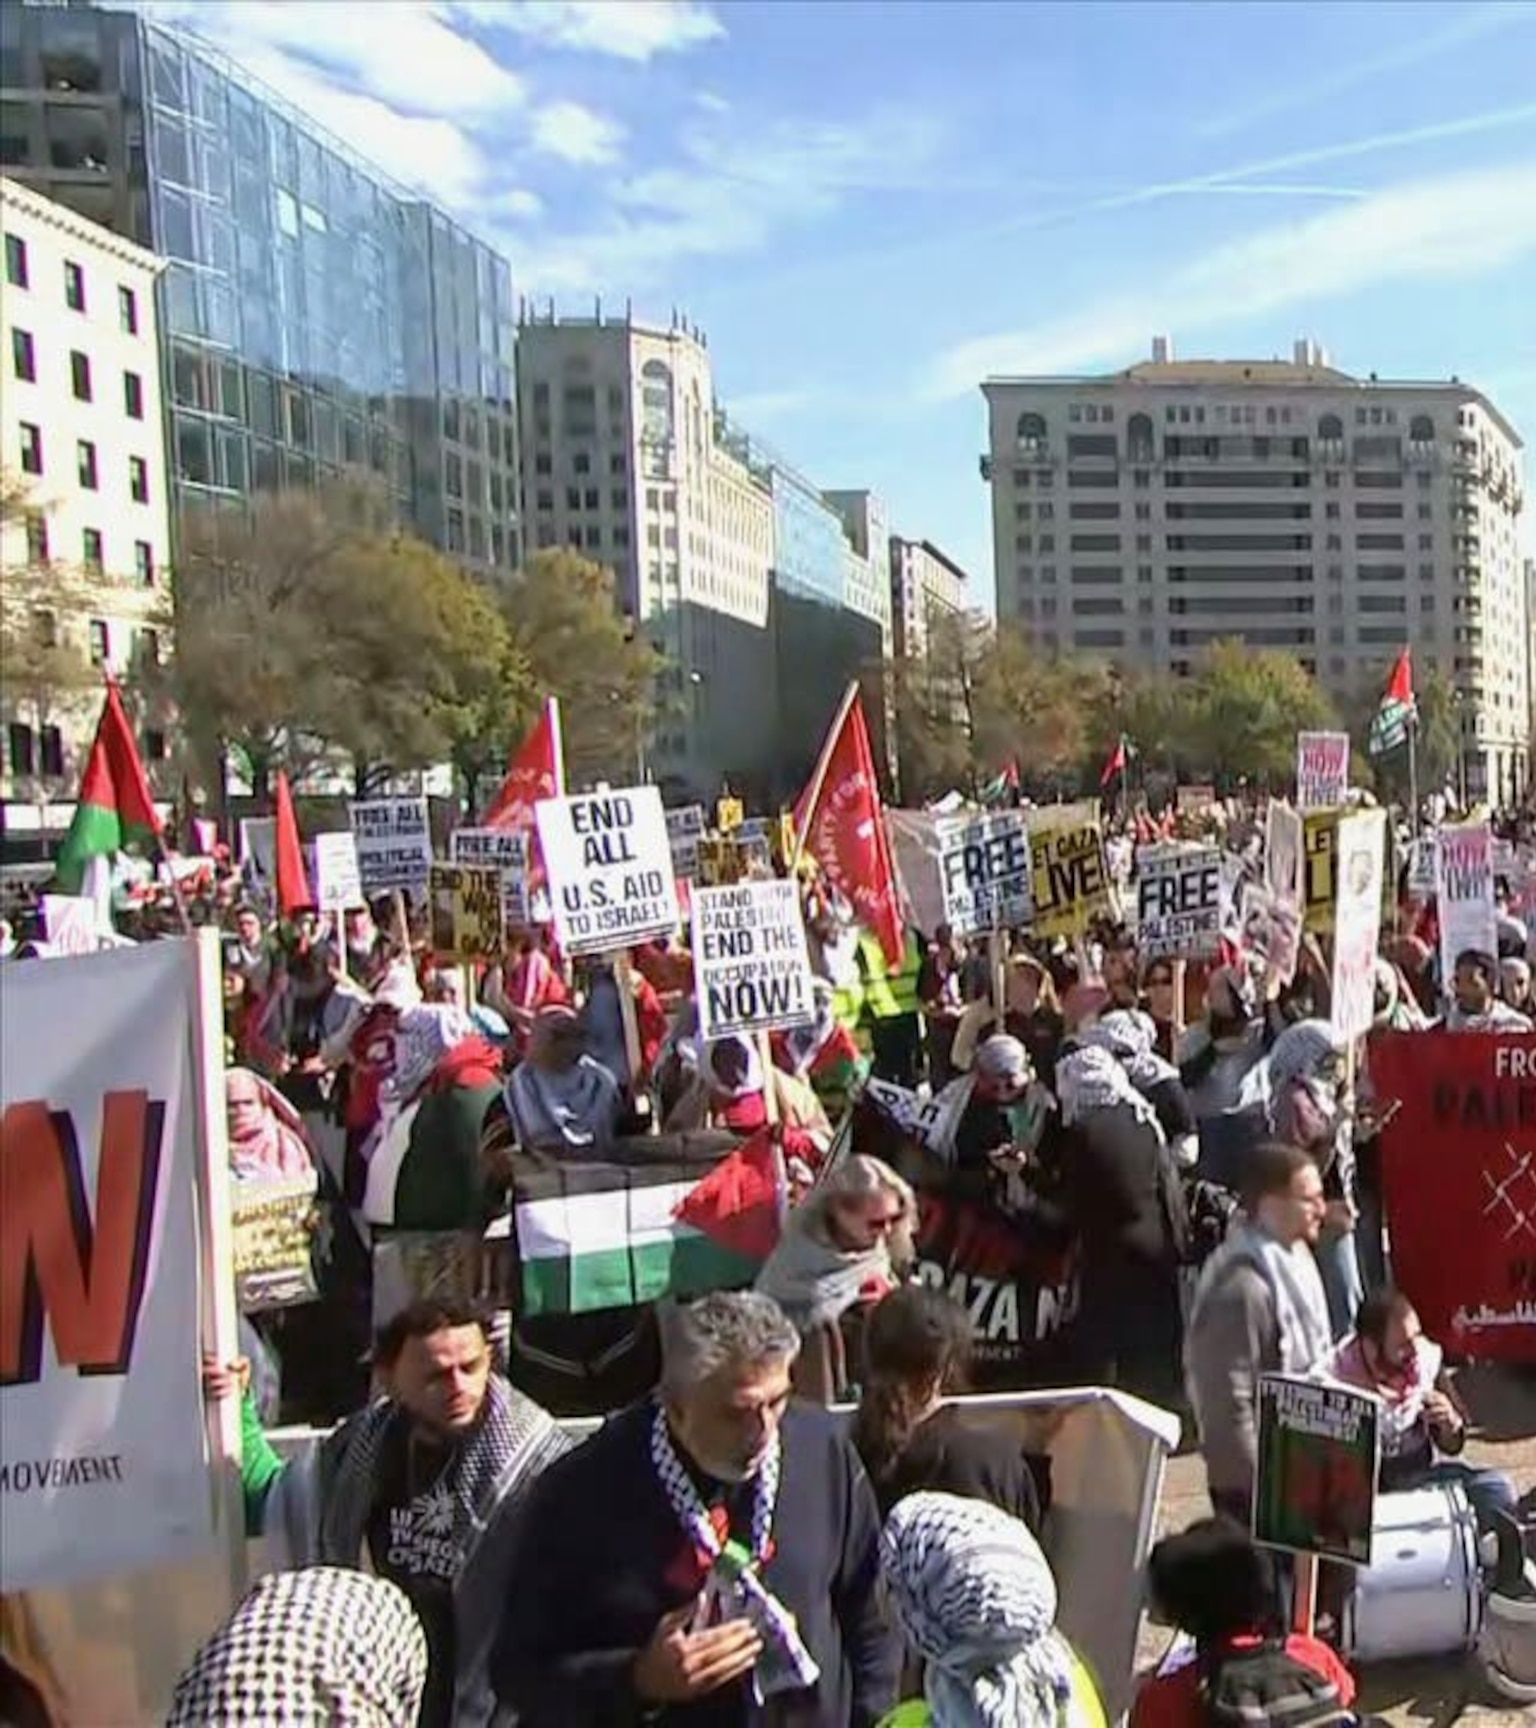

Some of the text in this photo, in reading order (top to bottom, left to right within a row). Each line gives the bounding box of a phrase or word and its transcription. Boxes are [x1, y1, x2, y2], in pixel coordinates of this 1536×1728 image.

[570, 797, 633, 834] END
[584, 832, 637, 868] ALL
[943, 829, 1027, 894] FREE
[562, 870, 664, 912] U.S. AID
[700, 888, 752, 910] STAND
[1140, 868, 1219, 919] FREE
[565, 915, 591, 936] TO
[702, 930, 754, 960] END
[762, 925, 799, 953] THE
[708, 974, 804, 1022] NOW!
